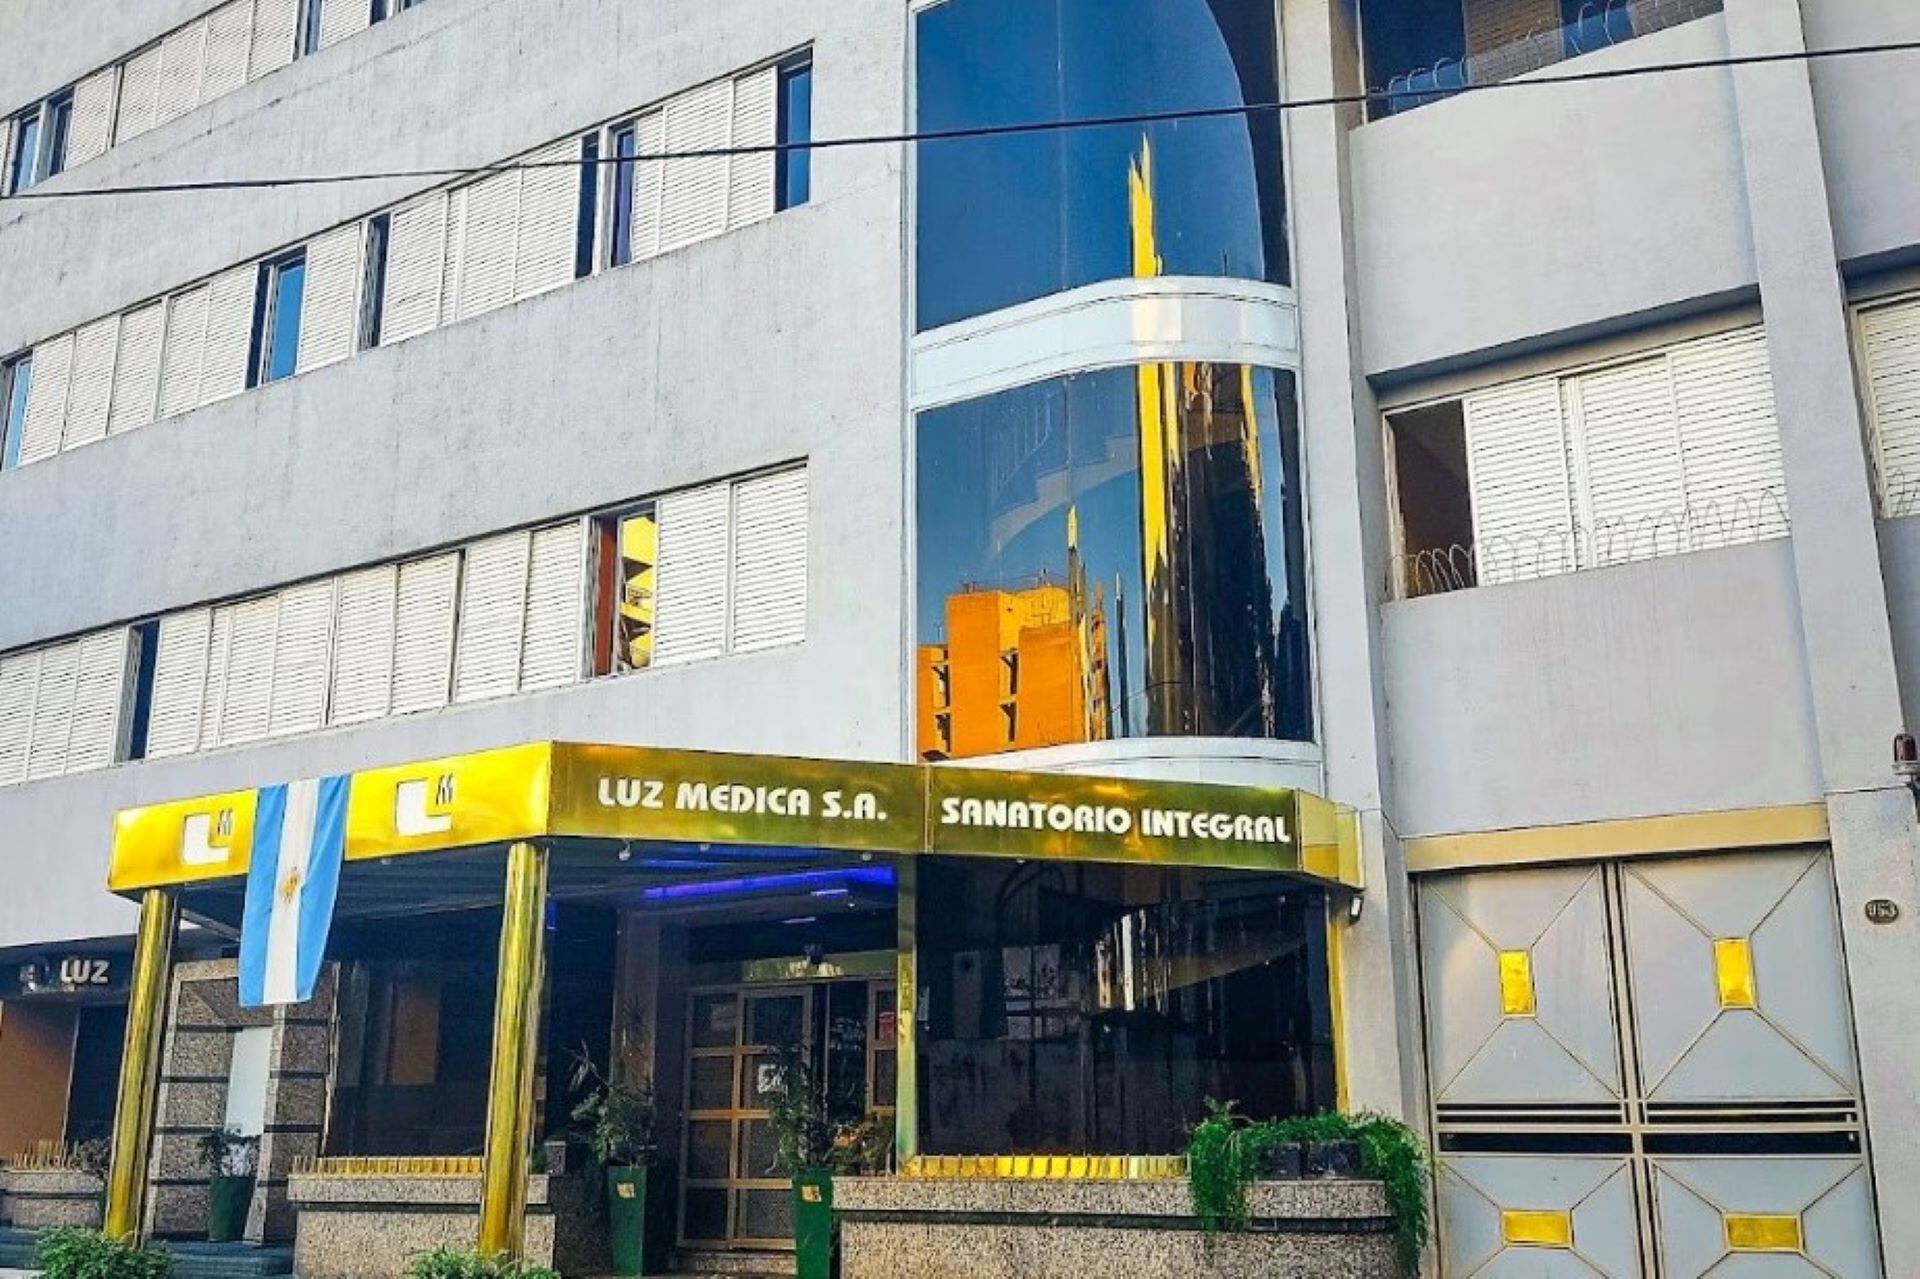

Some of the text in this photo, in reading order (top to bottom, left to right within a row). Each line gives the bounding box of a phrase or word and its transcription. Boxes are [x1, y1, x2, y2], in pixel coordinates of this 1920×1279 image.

[598, 776, 888, 820] LUZ MEDICA S.A.
[941, 797, 1291, 843] SANATORIO INTEGRAL
[60, 959, 110, 984] LUZ
